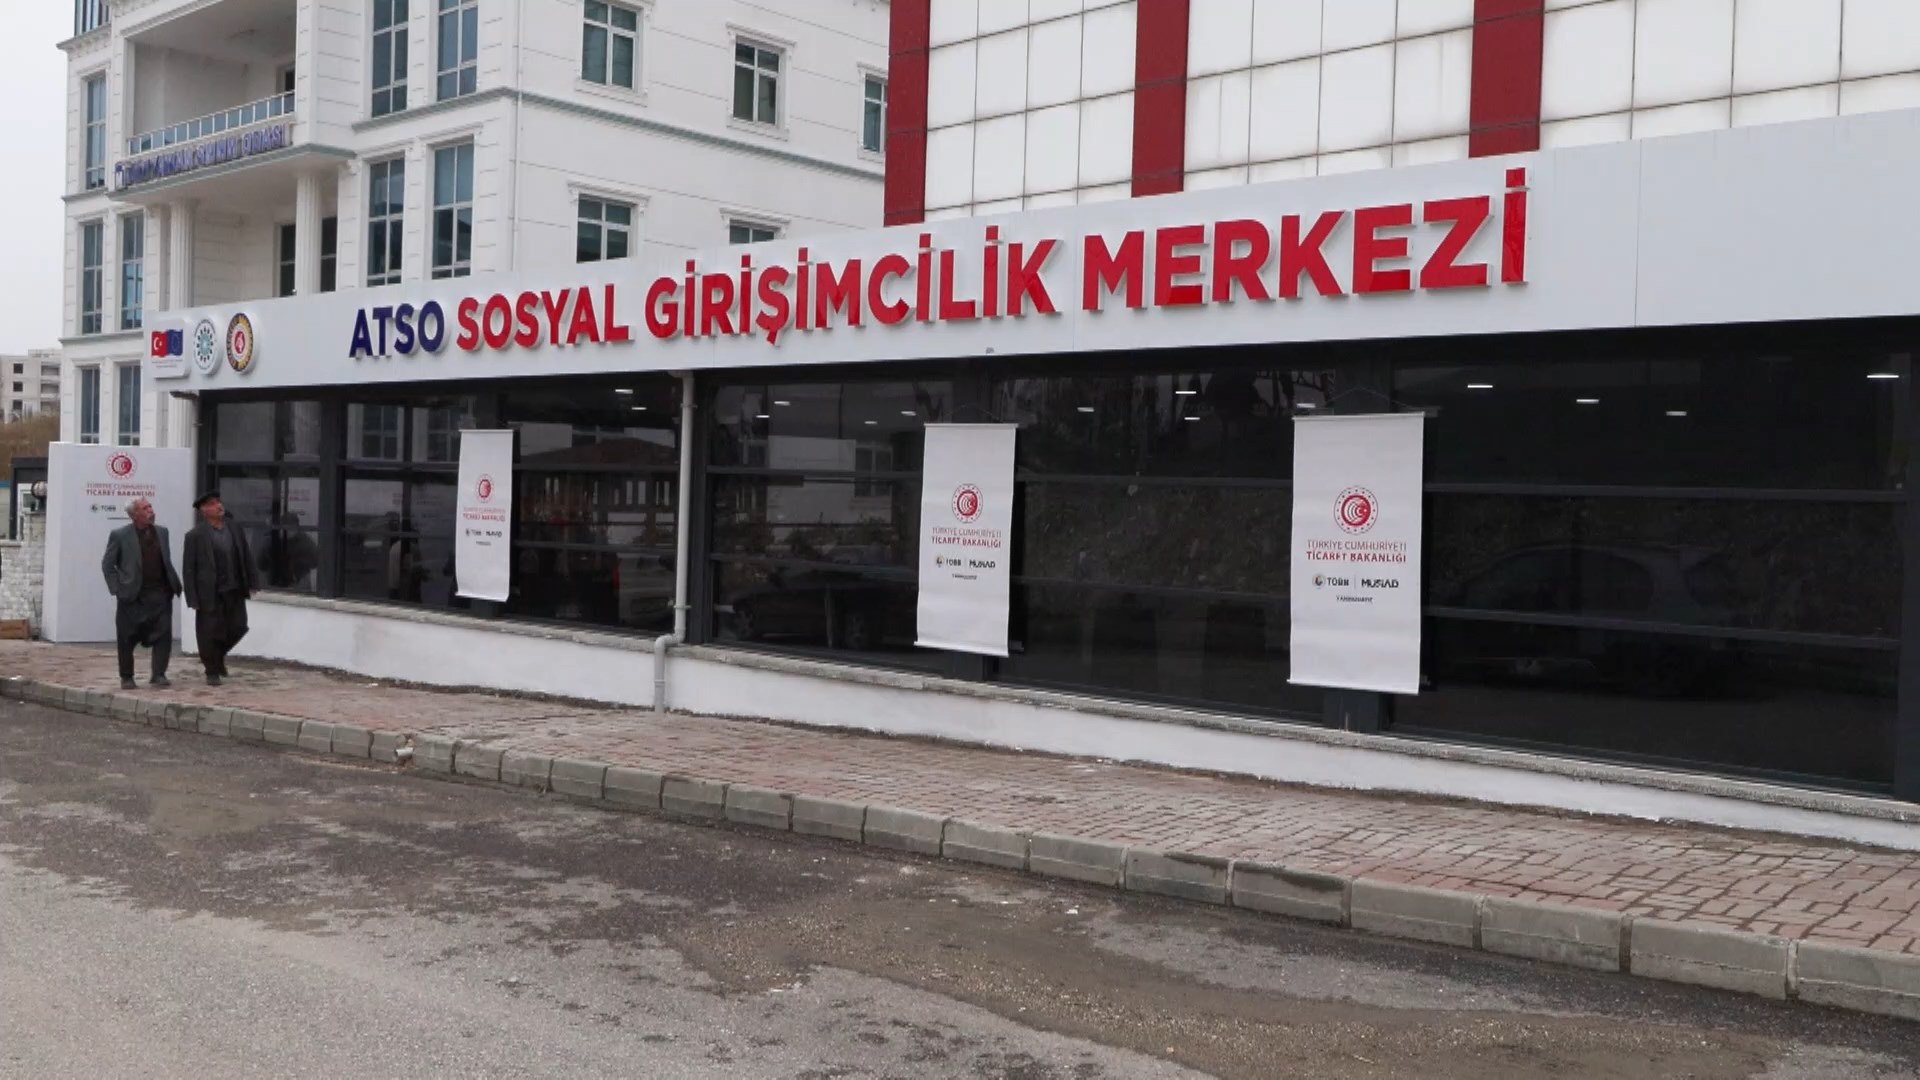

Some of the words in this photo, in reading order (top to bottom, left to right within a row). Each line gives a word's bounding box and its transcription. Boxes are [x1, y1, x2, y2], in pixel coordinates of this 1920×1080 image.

[350, 298, 444, 358] ATSO
[456, 283, 629, 352] SOSYAL
[645, 225, 1058, 346] GİRİŞİMCİLİK
[1083, 167, 1529, 314] MERKEZİ
[1306, 550, 1347, 561] TİCARET
